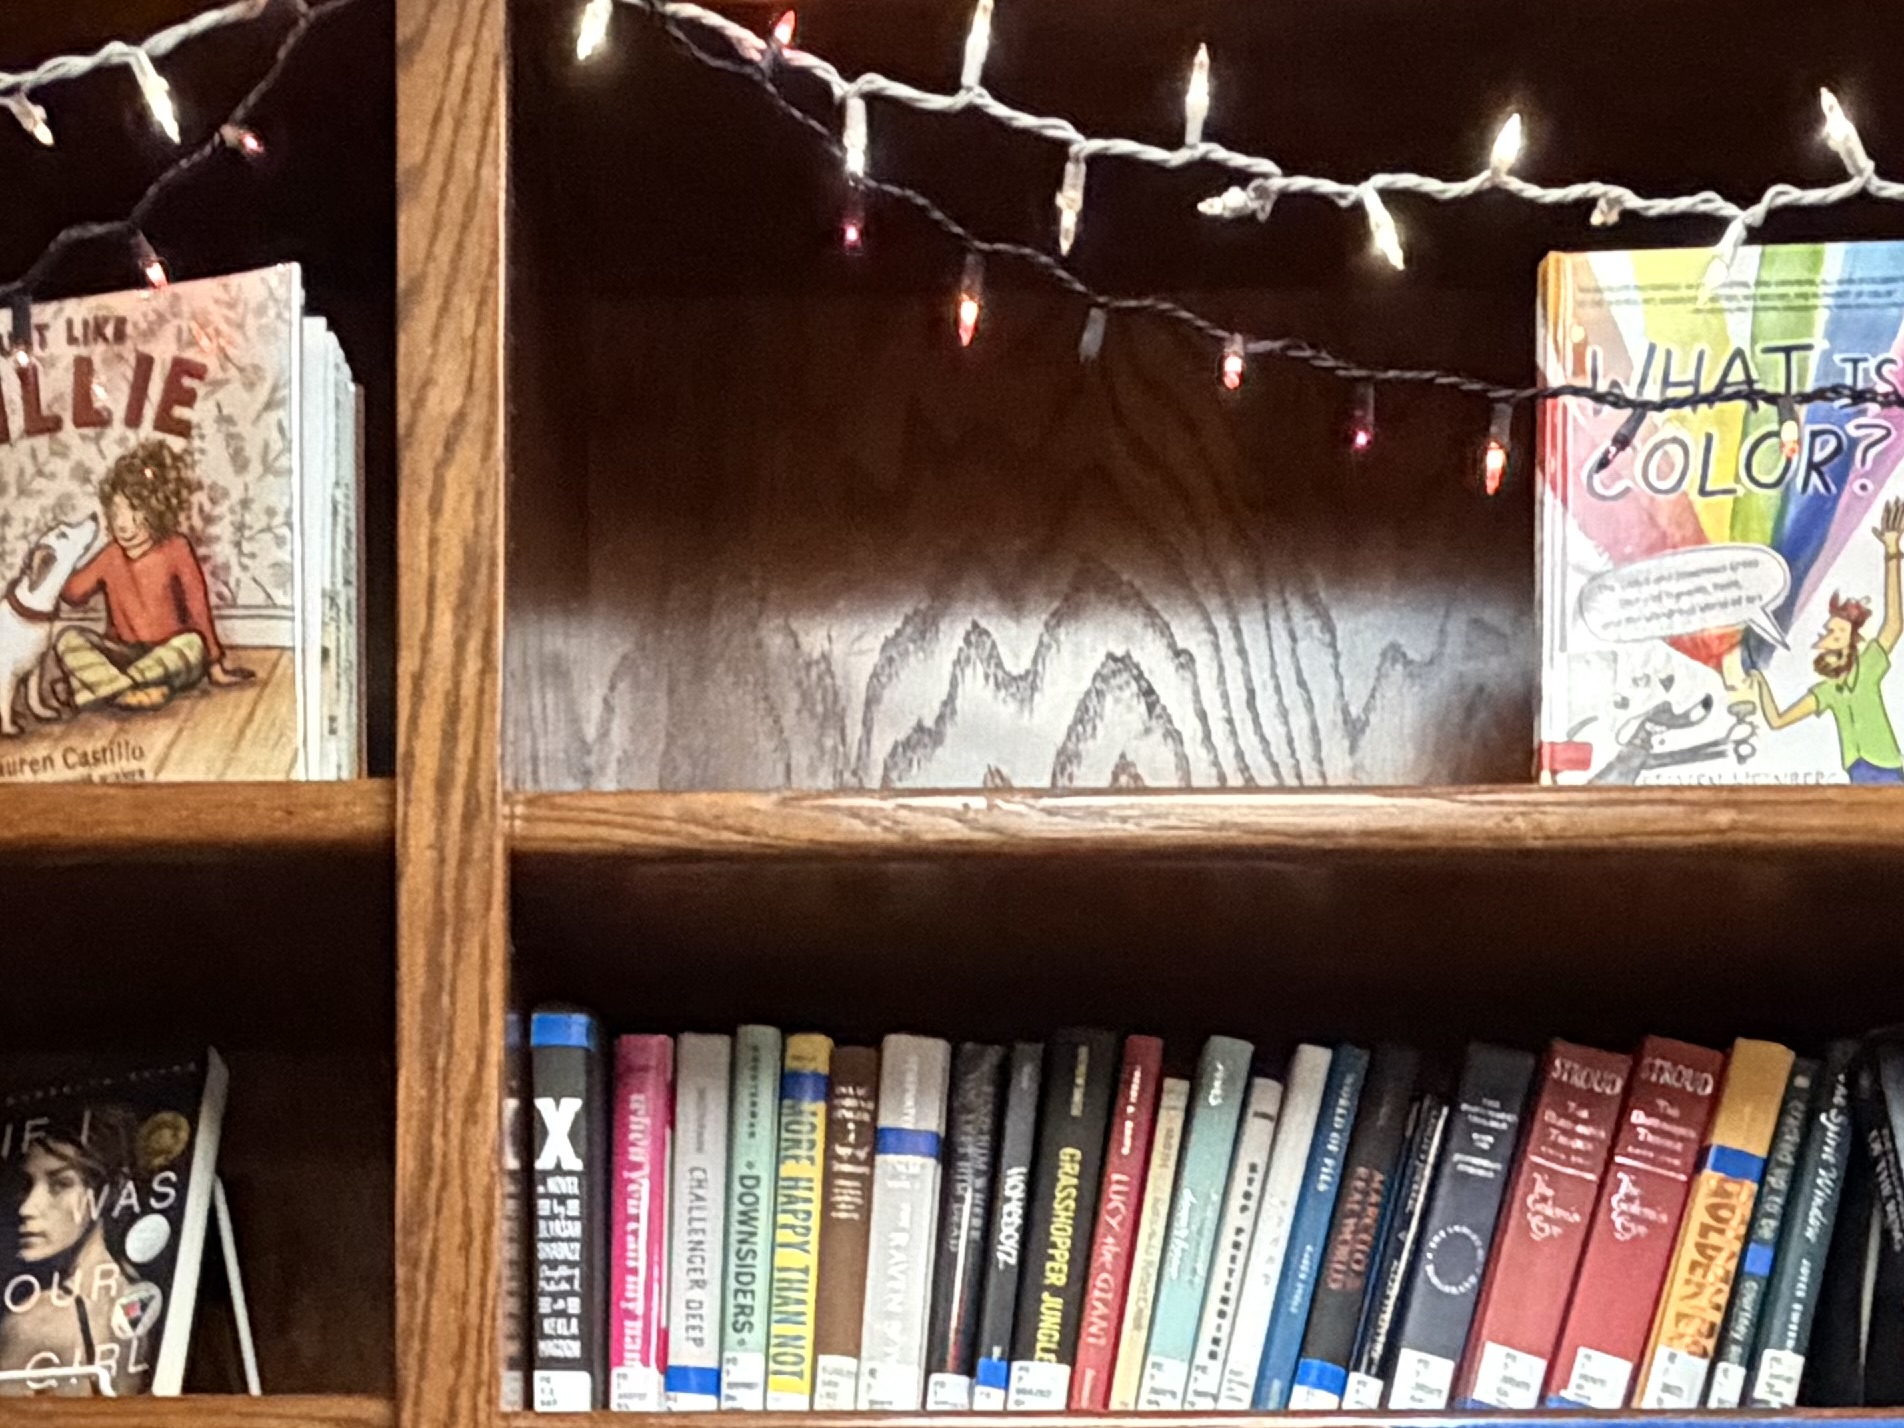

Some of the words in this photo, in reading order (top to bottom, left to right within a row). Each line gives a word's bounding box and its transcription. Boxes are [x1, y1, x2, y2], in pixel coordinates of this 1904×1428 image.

[67, 318, 127, 349] LIKE
[1587, 345, 1816, 413] WHAT
[1833, 352, 1902, 401] IS
[1585, 423, 1892, 499] COLOR?
[61, 740, 144, 773] Castillo
[1551, 1056, 1622, 1097] STROUD
[1640, 1056, 1714, 1097] STROUD
[0, 1116, 50, 1159] IF
[78, 1111, 93, 1145] I
[534, 1098, 584, 1169] X
[71, 1170, 178, 1225] WAS
[778, 1176, 813, 1254] HAPPY
[1044, 1147, 1082, 1285] GRASSHOPPER
[685, 1166, 709, 1292] CHALLENGER
[733, 1174, 760, 1334] DOWNSIDERS
[685, 1297, 706, 1347] DEEP
[776, 1266, 809, 1327] THAN
[1035, 1291, 1062, 1363] JUNGLE
[772, 1334, 806, 1381] NOT
